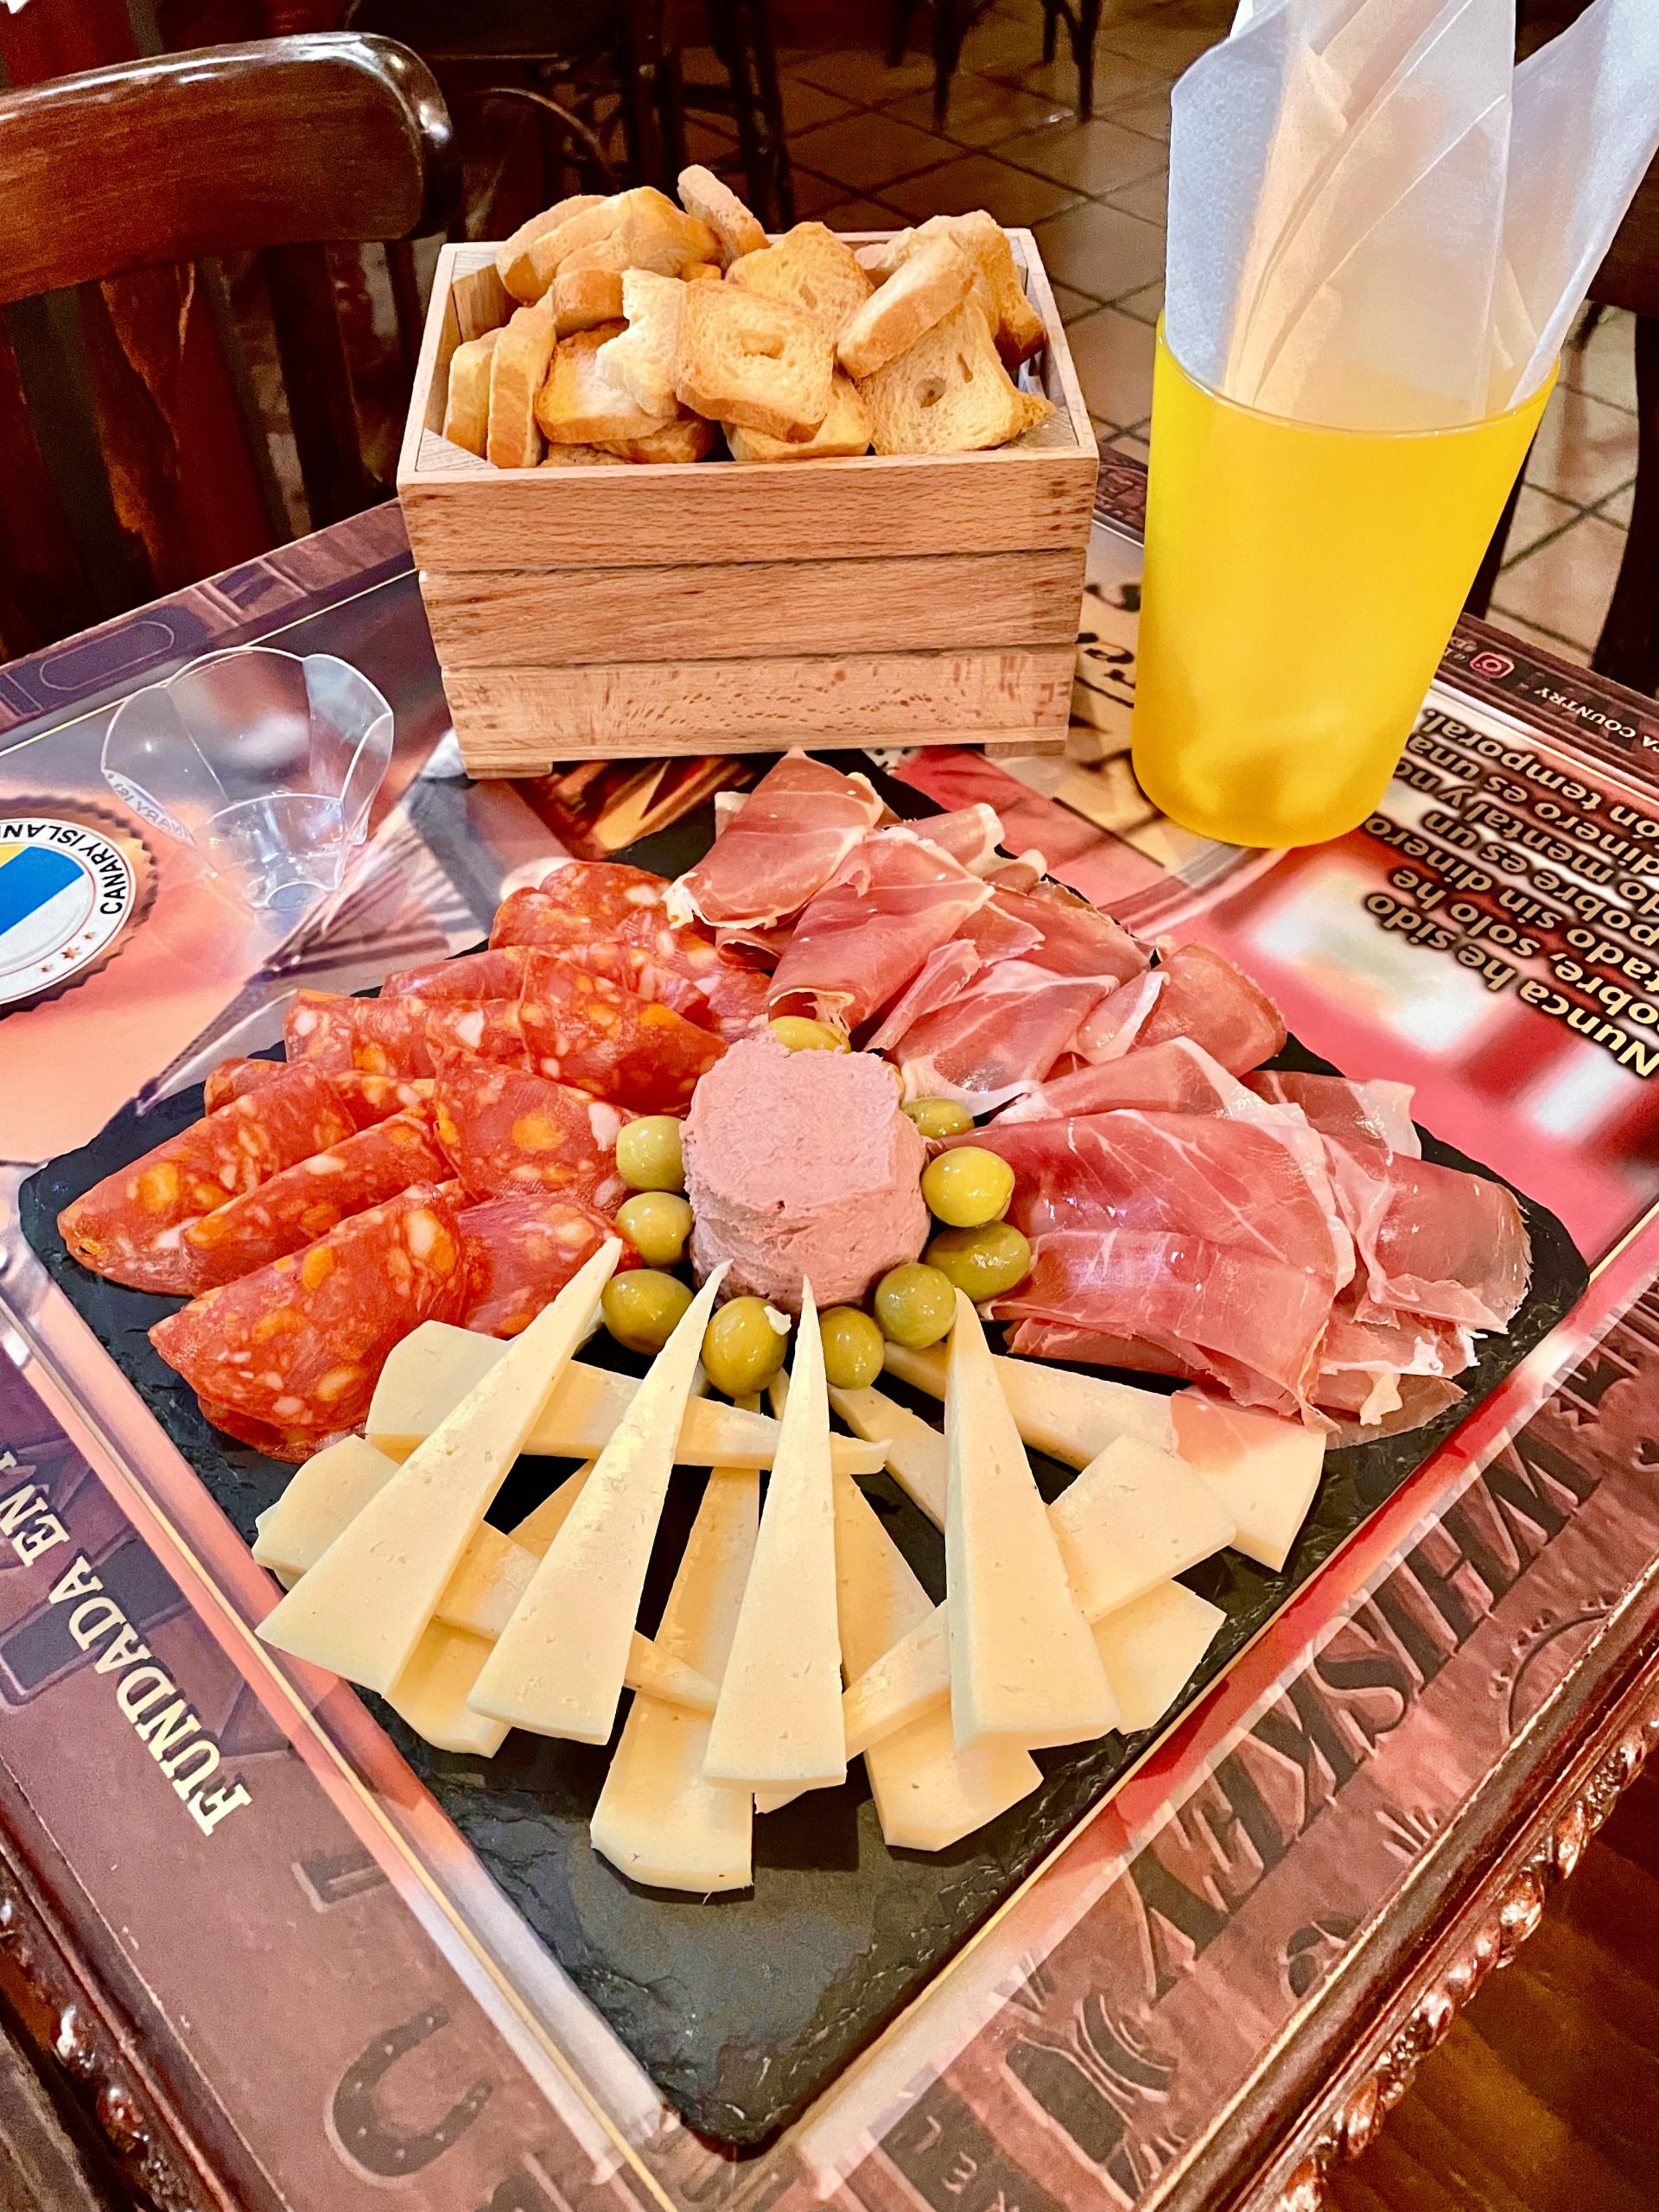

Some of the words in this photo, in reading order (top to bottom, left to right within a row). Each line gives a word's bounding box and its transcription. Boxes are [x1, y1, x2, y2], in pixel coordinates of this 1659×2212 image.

[1534, 687, 1636, 738] COUNTRY
[1395, 761, 1439, 790] no
[1408, 735, 1479, 779] una
[1427, 710, 1601, 810] temporal.
[1438, 787, 1472, 808] y
[1484, 776, 1528, 802] es
[0, 823, 86, 847] ISLAN
[1365, 818, 1492, 891] dinero
[1425, 812, 1477, 848] un
[1464, 803, 1614, 883] mental
[1535, 803, 1659, 874] dinero
[78, 842, 127, 914] CANARY
[1480, 844, 1528, 873] es
[1393, 870, 1446, 910] he
[1499, 889, 1562, 928] sin
[1534, 872, 1659, 946] pobre
[1367, 895, 1457, 949] sido
[1451, 903, 1541, 956] solo
[1458, 945, 1516, 991] he
[1550, 953, 1659, 1035] obre,
[1520, 980, 1659, 1077] Nunca
[0, 1484, 70, 1567] EN
[48, 1555, 252, 1837] FUNDADA
